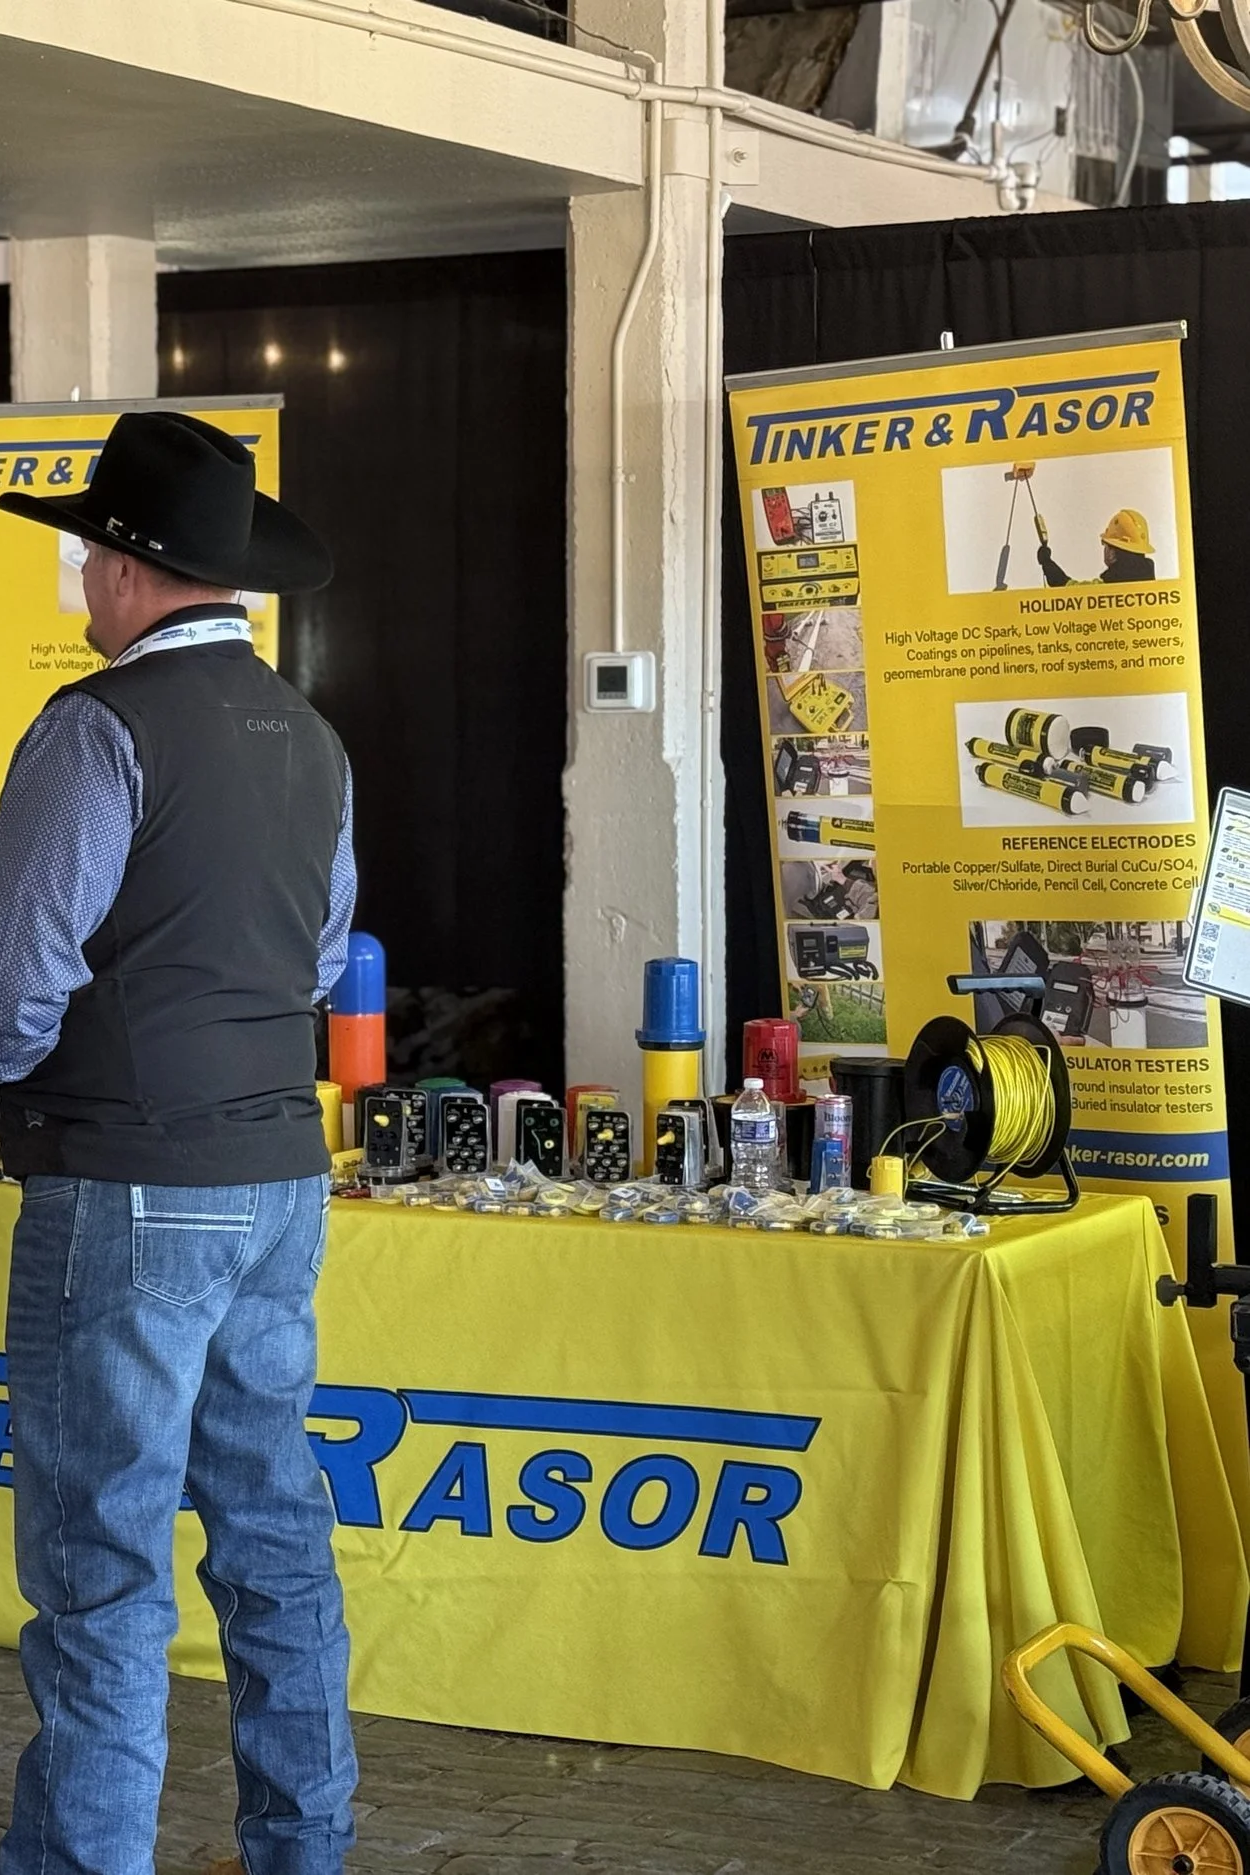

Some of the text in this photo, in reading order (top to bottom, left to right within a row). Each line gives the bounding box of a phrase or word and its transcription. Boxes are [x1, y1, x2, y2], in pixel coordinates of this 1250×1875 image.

[746, 384, 1156, 466] TINKER & RASOR
[46, 456, 74, 486] &
[1020, 590, 1181, 614] HOLIDAY DETECTORS
[885, 617, 1183, 647] High Voltage DC Spark, Low Voltage Wet Sponge,
[31, 643, 56, 657] High
[906, 636, 1184, 662] Coatings on pipelines, tanks, concrete, sewers,
[29, 659, 51, 670] Low
[54, 659, 94, 672] Voltage
[883, 655, 1185, 684] geomembrane pond liners, roof systems, and more
[246, 719, 290, 733] CINCH
[1002, 834, 1196, 850] REFERENCE ELECTRODES
[902, 861, 951, 874] Portable
[953, 860, 1045, 876] Copper/Sulfate,
[1047, 860, 1083, 873] Direct
[1085, 859, 1118, 873] Burial
[1121, 858, 1198, 873] CuCu/SO4,
[1044, 877, 1079, 891] Pencil
[1082, 878, 1107, 892] Cell,
[1109, 878, 1168, 891] Concrete
[1066, 1056, 1210, 1073] SULATOR TESTERS
[1071, 1081, 1212, 1095] round insulator testers
[1110, 1099, 1162, 1113] insulator
[1165, 1101, 1214, 1114] testers
[303, 1384, 801, 1567] RASOR
